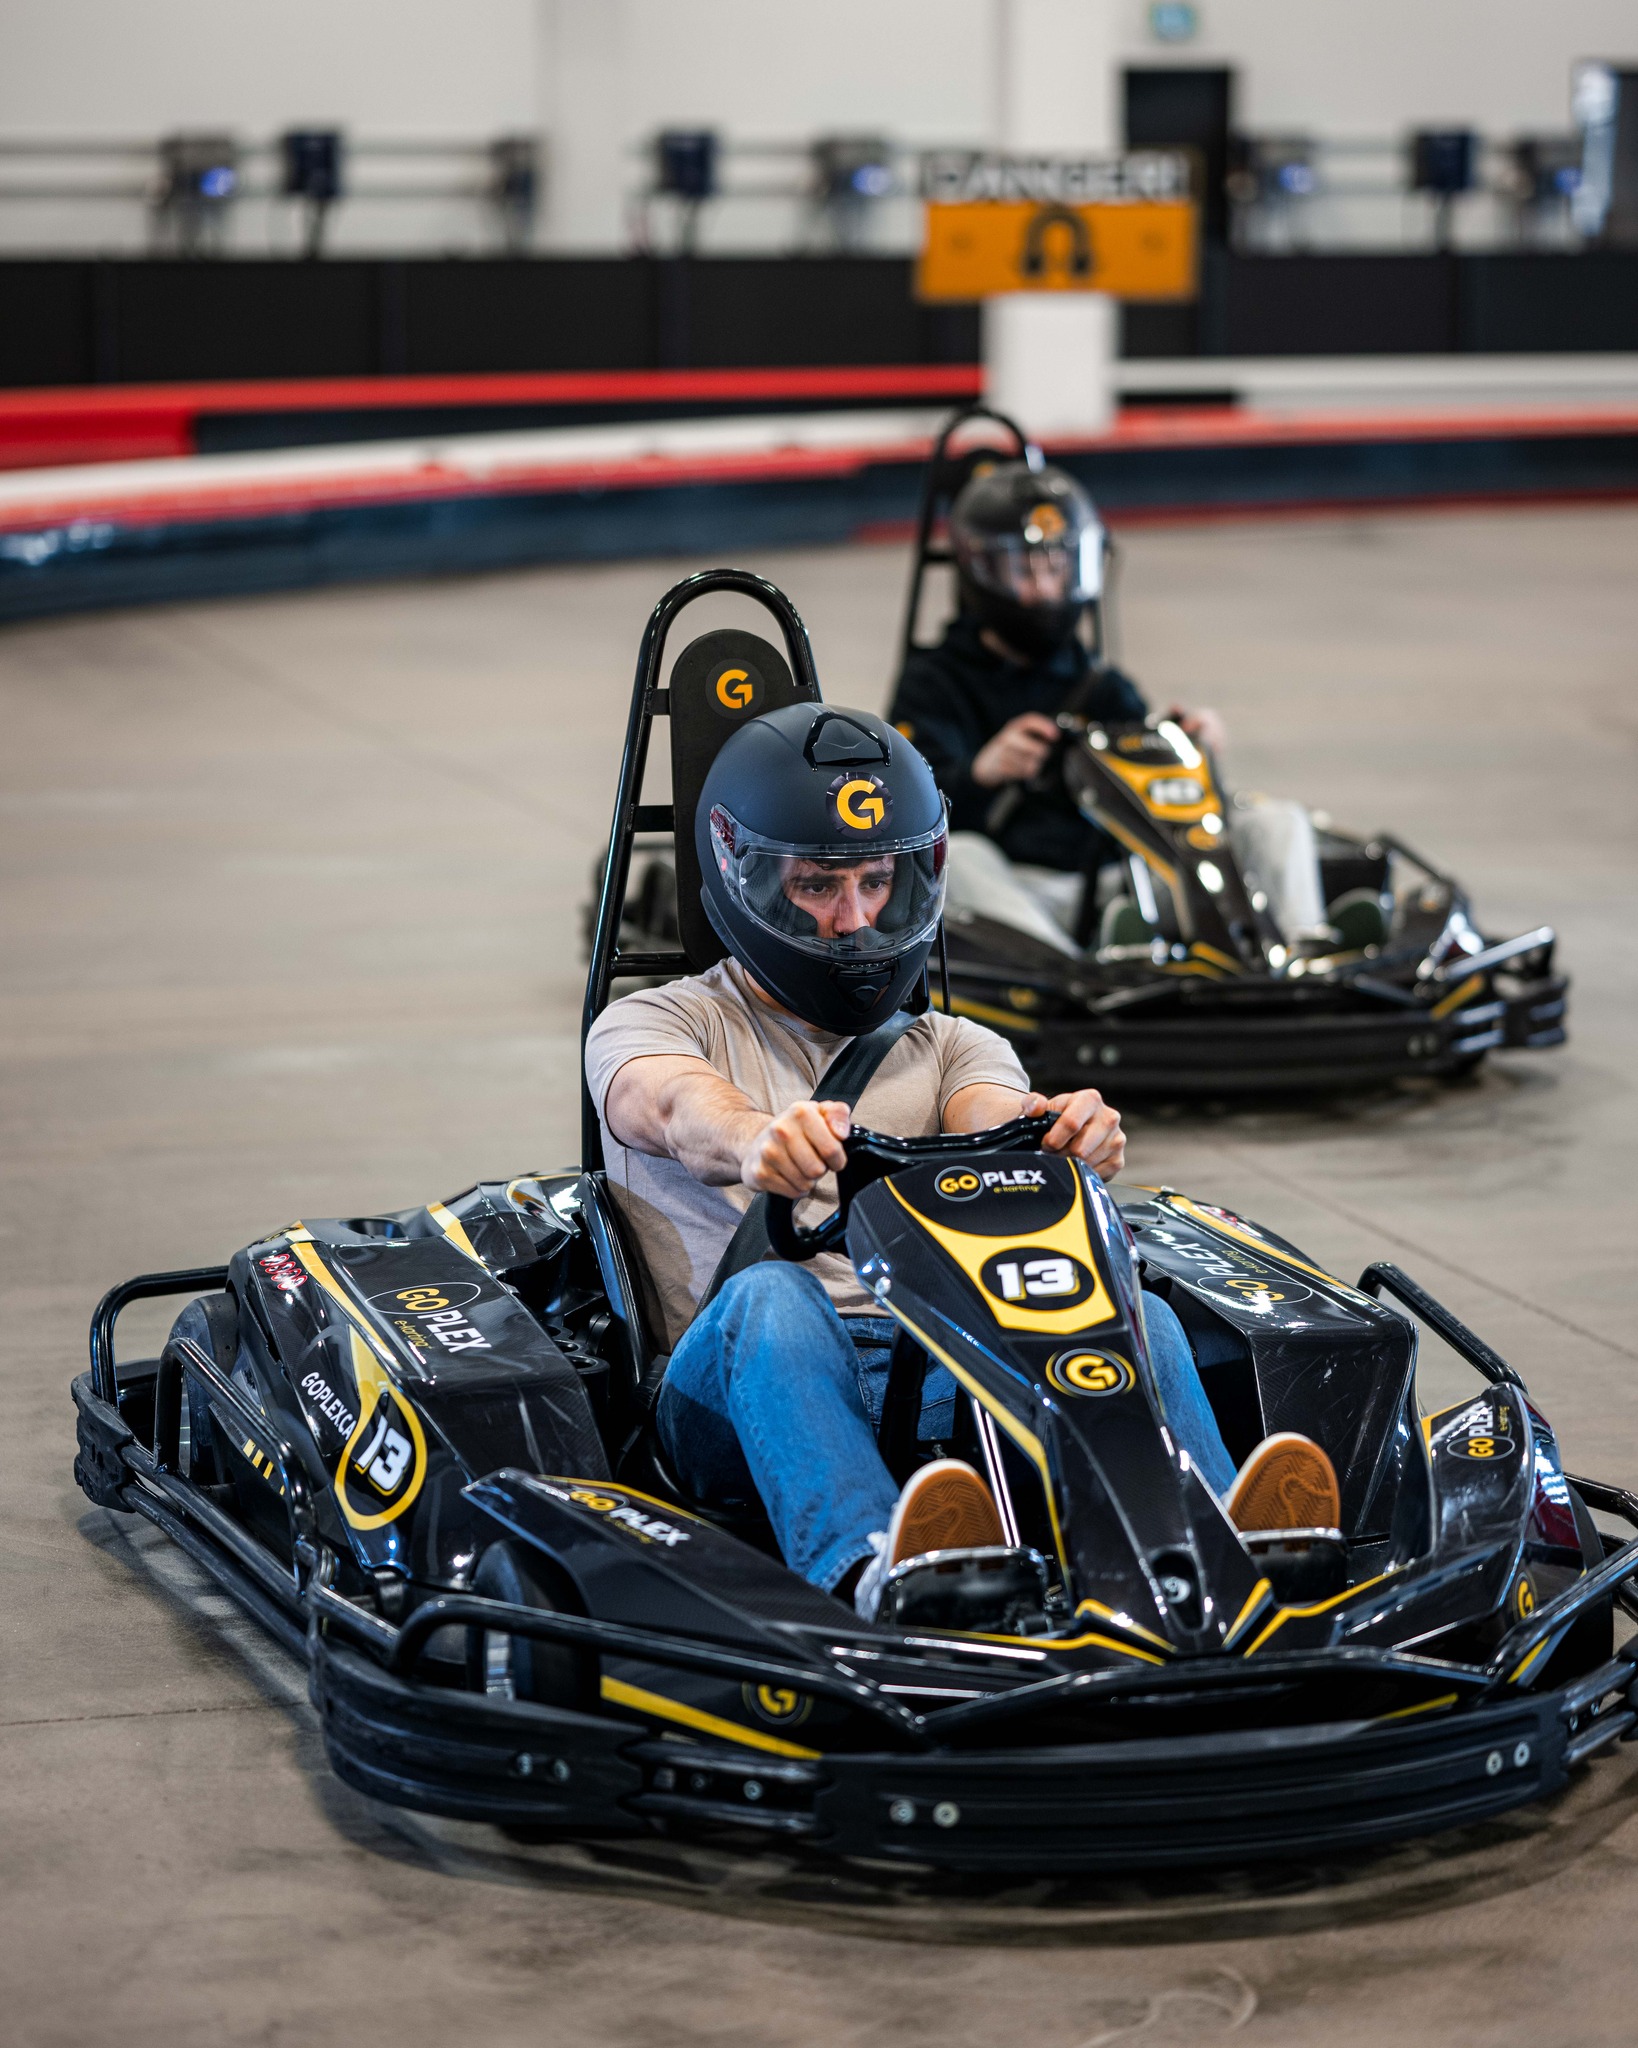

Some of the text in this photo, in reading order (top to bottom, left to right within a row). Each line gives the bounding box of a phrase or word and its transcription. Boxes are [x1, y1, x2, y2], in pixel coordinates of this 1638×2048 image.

[716, 669, 753, 709] G
[837, 780, 885, 829] G
[996, 1258, 1080, 1301] 13
[1065, 1355, 1118, 1390] G
[356, 1415, 412, 1494] 13
